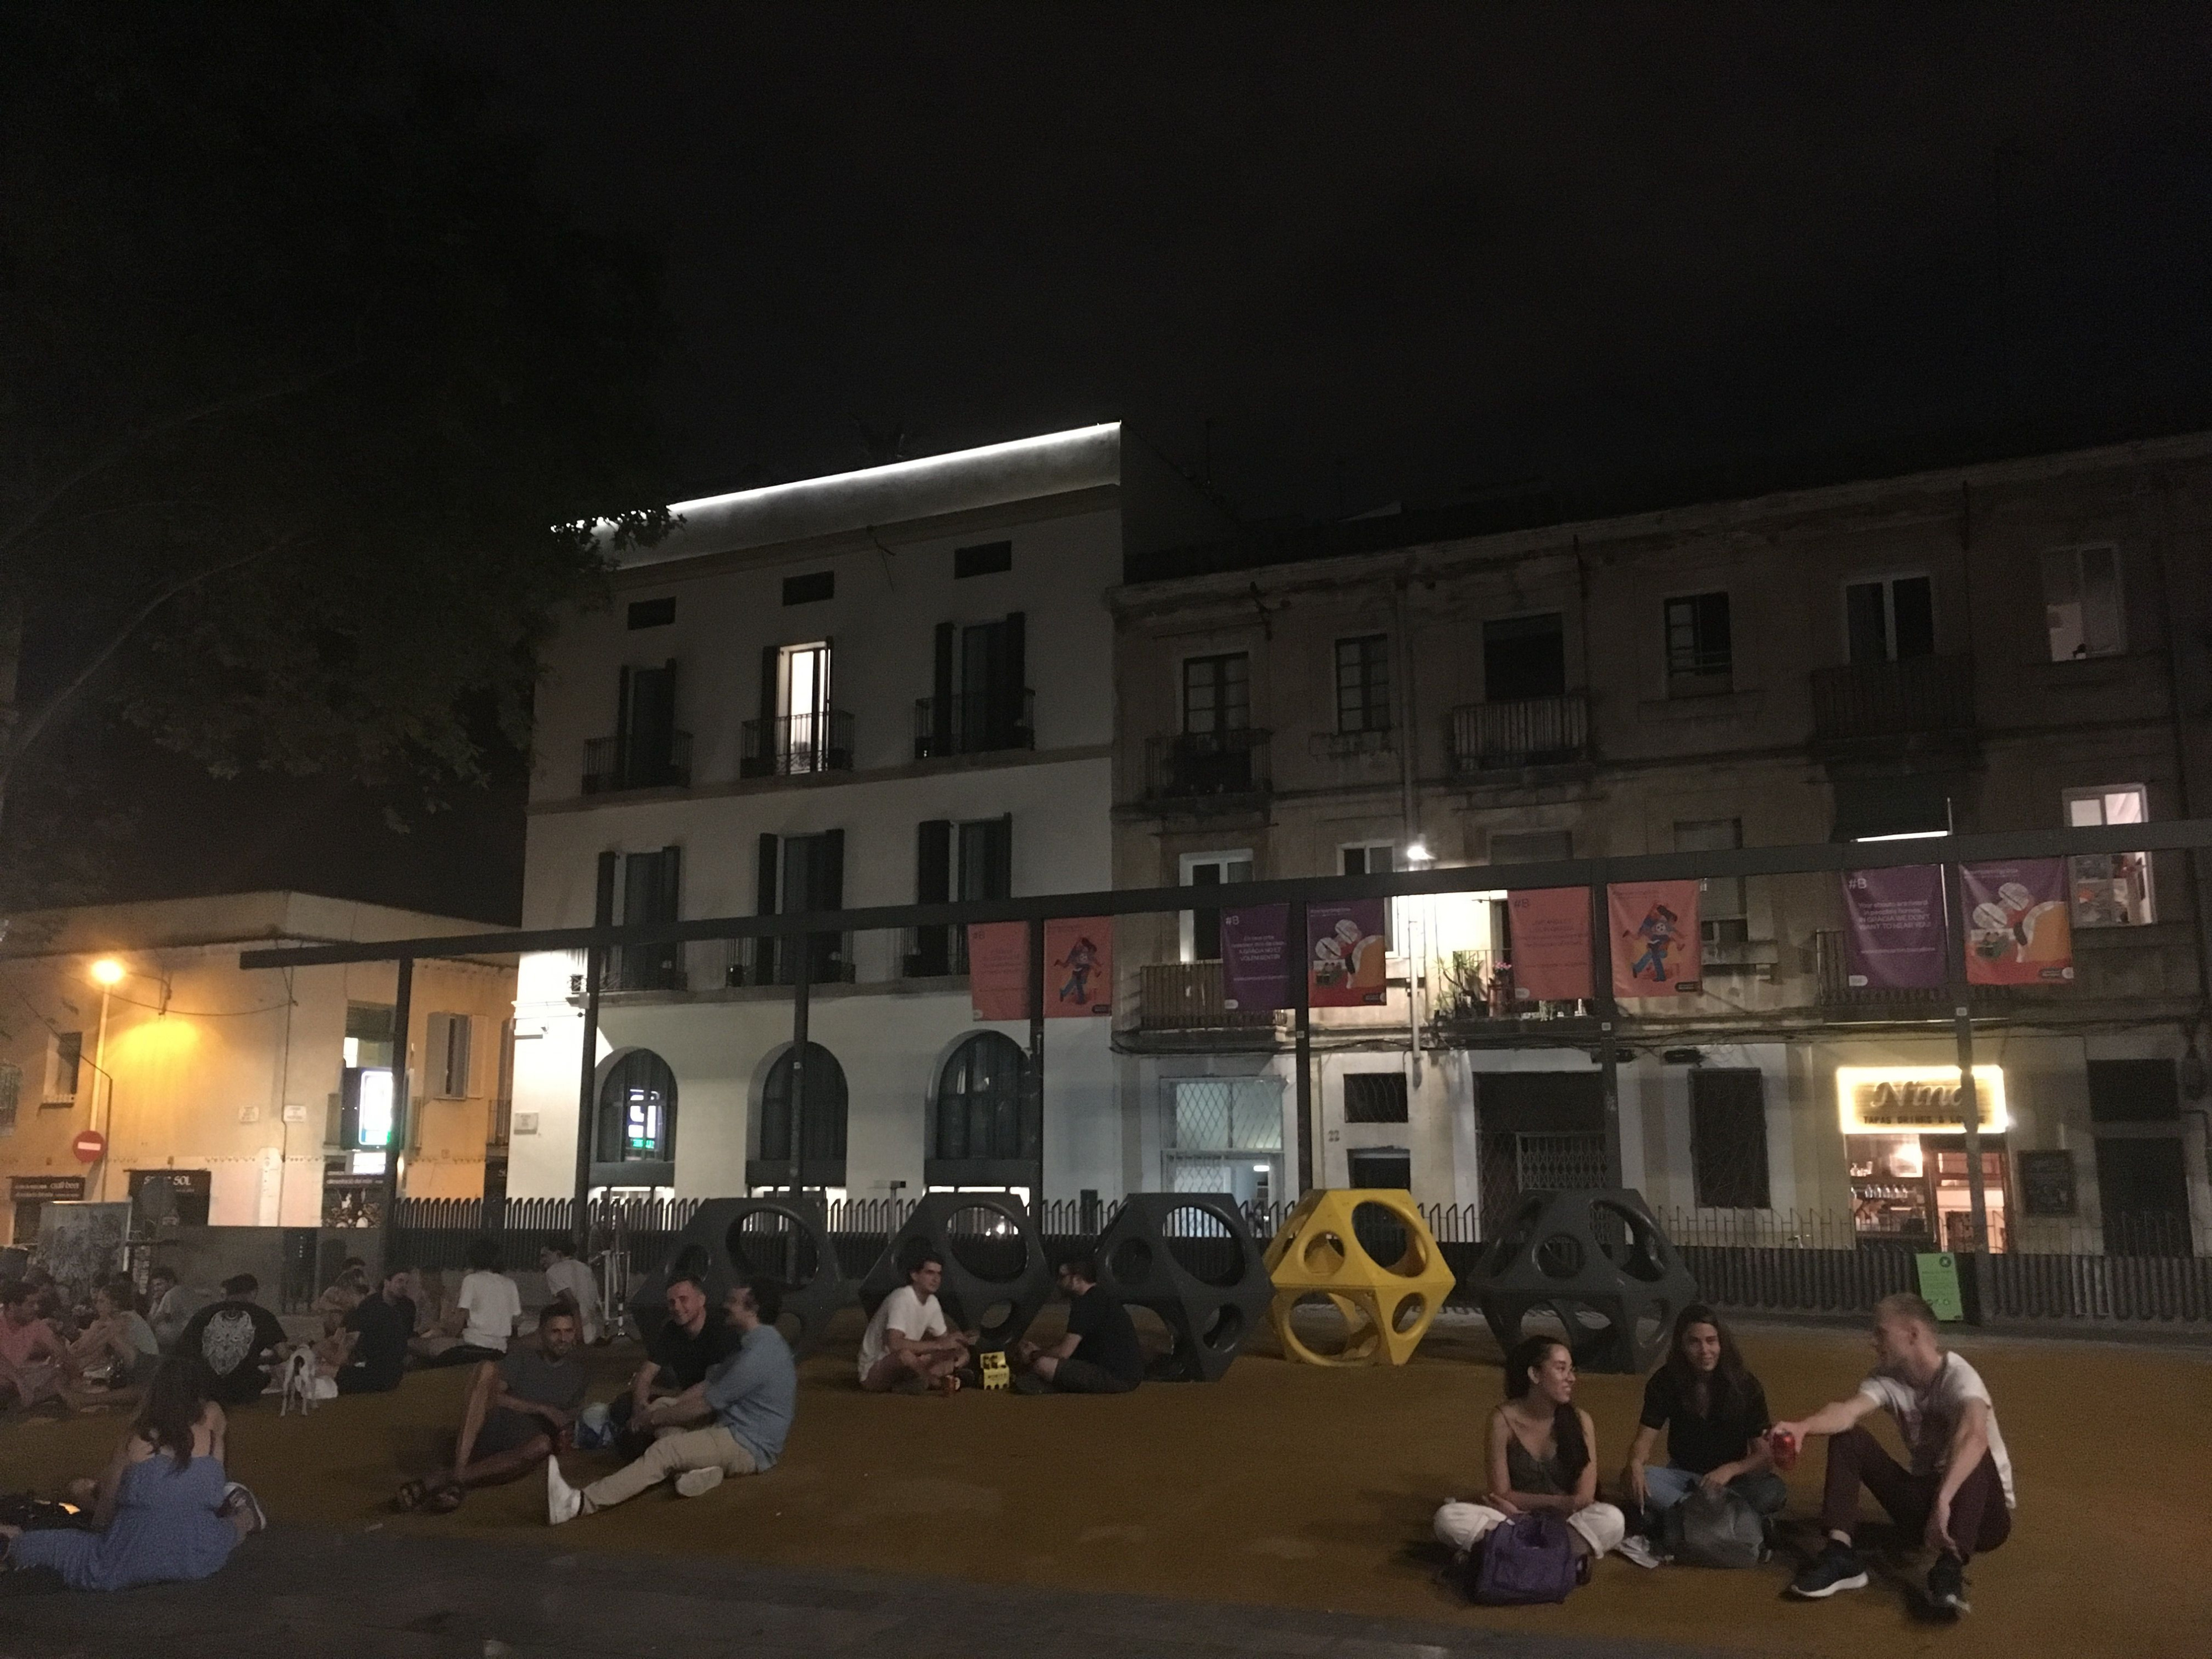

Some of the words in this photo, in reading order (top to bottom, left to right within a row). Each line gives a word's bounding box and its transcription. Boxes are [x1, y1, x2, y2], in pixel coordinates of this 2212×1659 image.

[1849, 878, 1867, 889] #B
[1225, 915, 1239, 925] #B
[1863, 1115, 1891, 1124] TAPAS
[1897, 1115, 1932, 1124] DRINKS
[1328, 1130, 1339, 1142] 22
[173, 1175, 191, 1186] SOL
